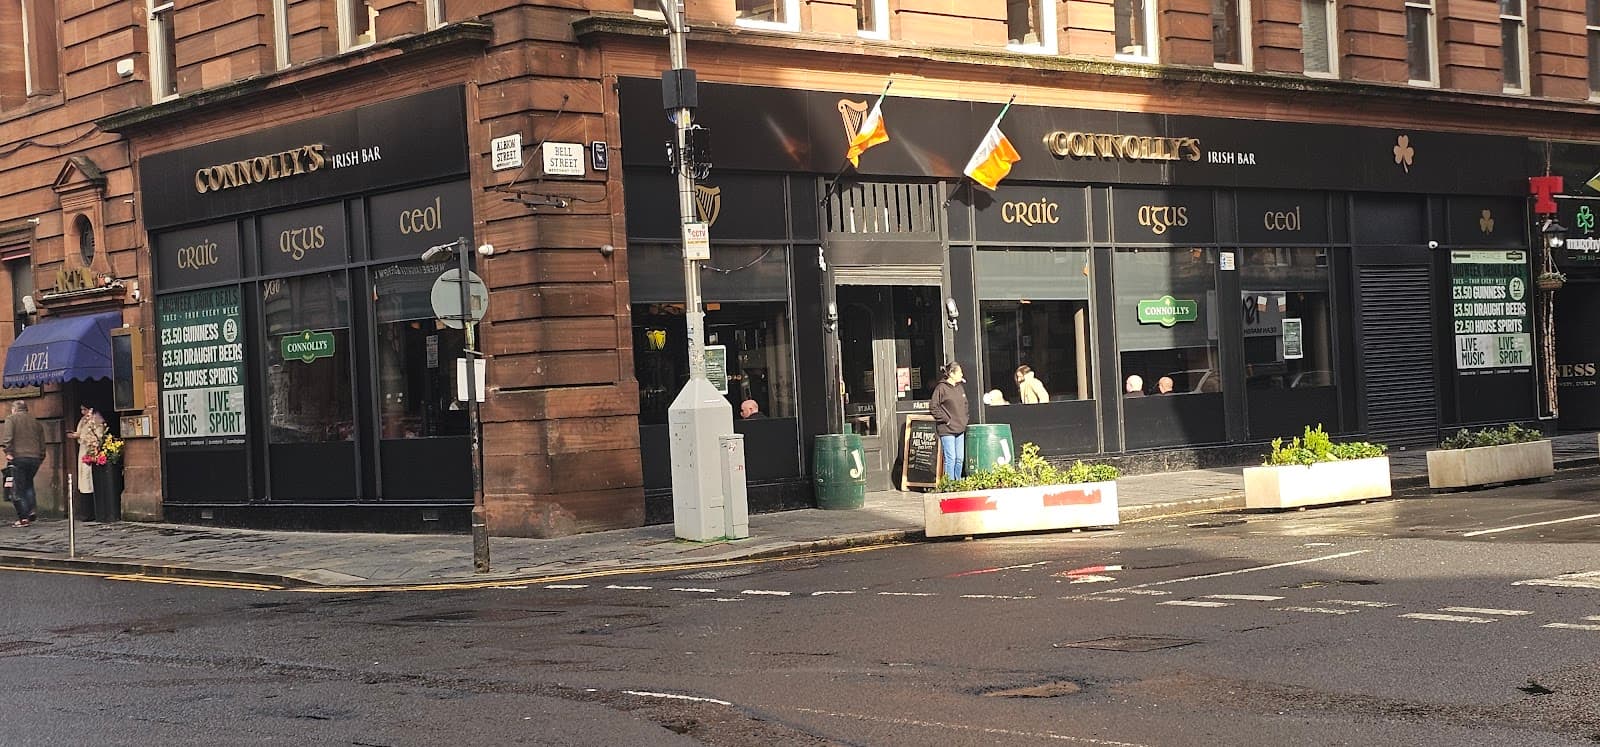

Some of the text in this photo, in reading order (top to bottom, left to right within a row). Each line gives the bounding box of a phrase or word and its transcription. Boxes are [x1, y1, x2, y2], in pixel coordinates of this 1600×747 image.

[496, 138, 515, 151] ALBION
[554, 146, 573, 157] BELL
[1047, 131, 1256, 165] CONNOLLY'S IRISH BAR
[496, 150, 516, 162] STREET
[550, 158, 578, 168] STREET
[195, 144, 382, 194] CONNOLLY'S IRISH BAR
[1529, 175, 1564, 214] T
[399, 196, 442, 235] ceol
[1263, 206, 1301, 231] ceol
[215, 286, 238, 308] DEALS
[1453, 285, 1506, 300] £3.50 GUINNESS
[223, 306, 239, 315] WEEK
[1145, 306, 1190, 315] CONNOLLY'S
[1453, 302, 1527, 317] £3.50 DRAUGHT BEERS
[1454, 318, 1523, 334] £2.50 HOUSE SPIRITS
[161, 323, 219, 346] £3.50 GUINNESS
[287, 340, 328, 353] CONNOLLY'S
[1460, 337, 1478, 352] LIVE
[1498, 337, 1515, 350] LIVE
[162, 343, 243, 367] £3.50 DRAUGHT BEERS
[1461, 351, 1485, 366] MUSIC
[1499, 350, 1523, 364] SPORT
[163, 366, 239, 389] £2.50 HOUSE SPIRITS
[167, 393, 189, 415] LIVE
[208, 390, 230, 412] LIVE
[168, 414, 198, 436] MUSIC
[209, 411, 242, 434] SPORT
